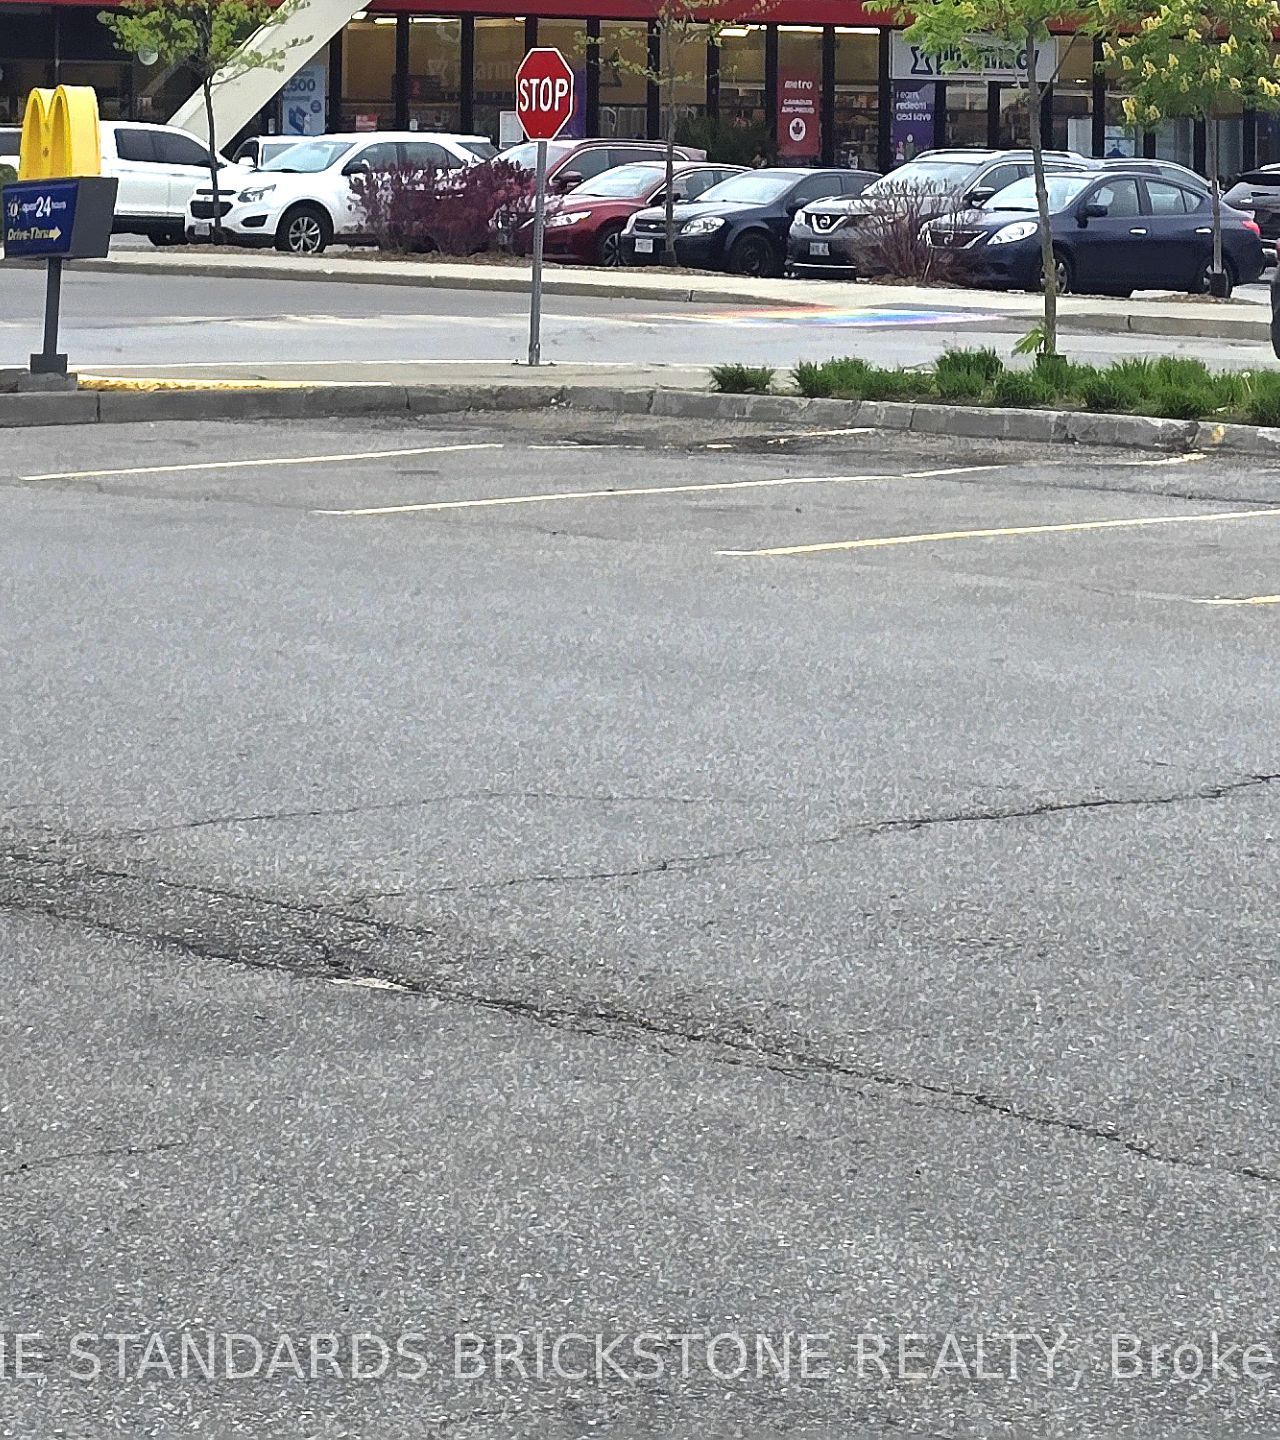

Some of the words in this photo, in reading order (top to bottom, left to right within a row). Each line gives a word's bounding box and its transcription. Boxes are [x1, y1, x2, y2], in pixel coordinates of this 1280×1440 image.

[519, 76, 569, 112] STOP
[784, 80, 813, 90] metro
[35, 195, 51, 217] 24
